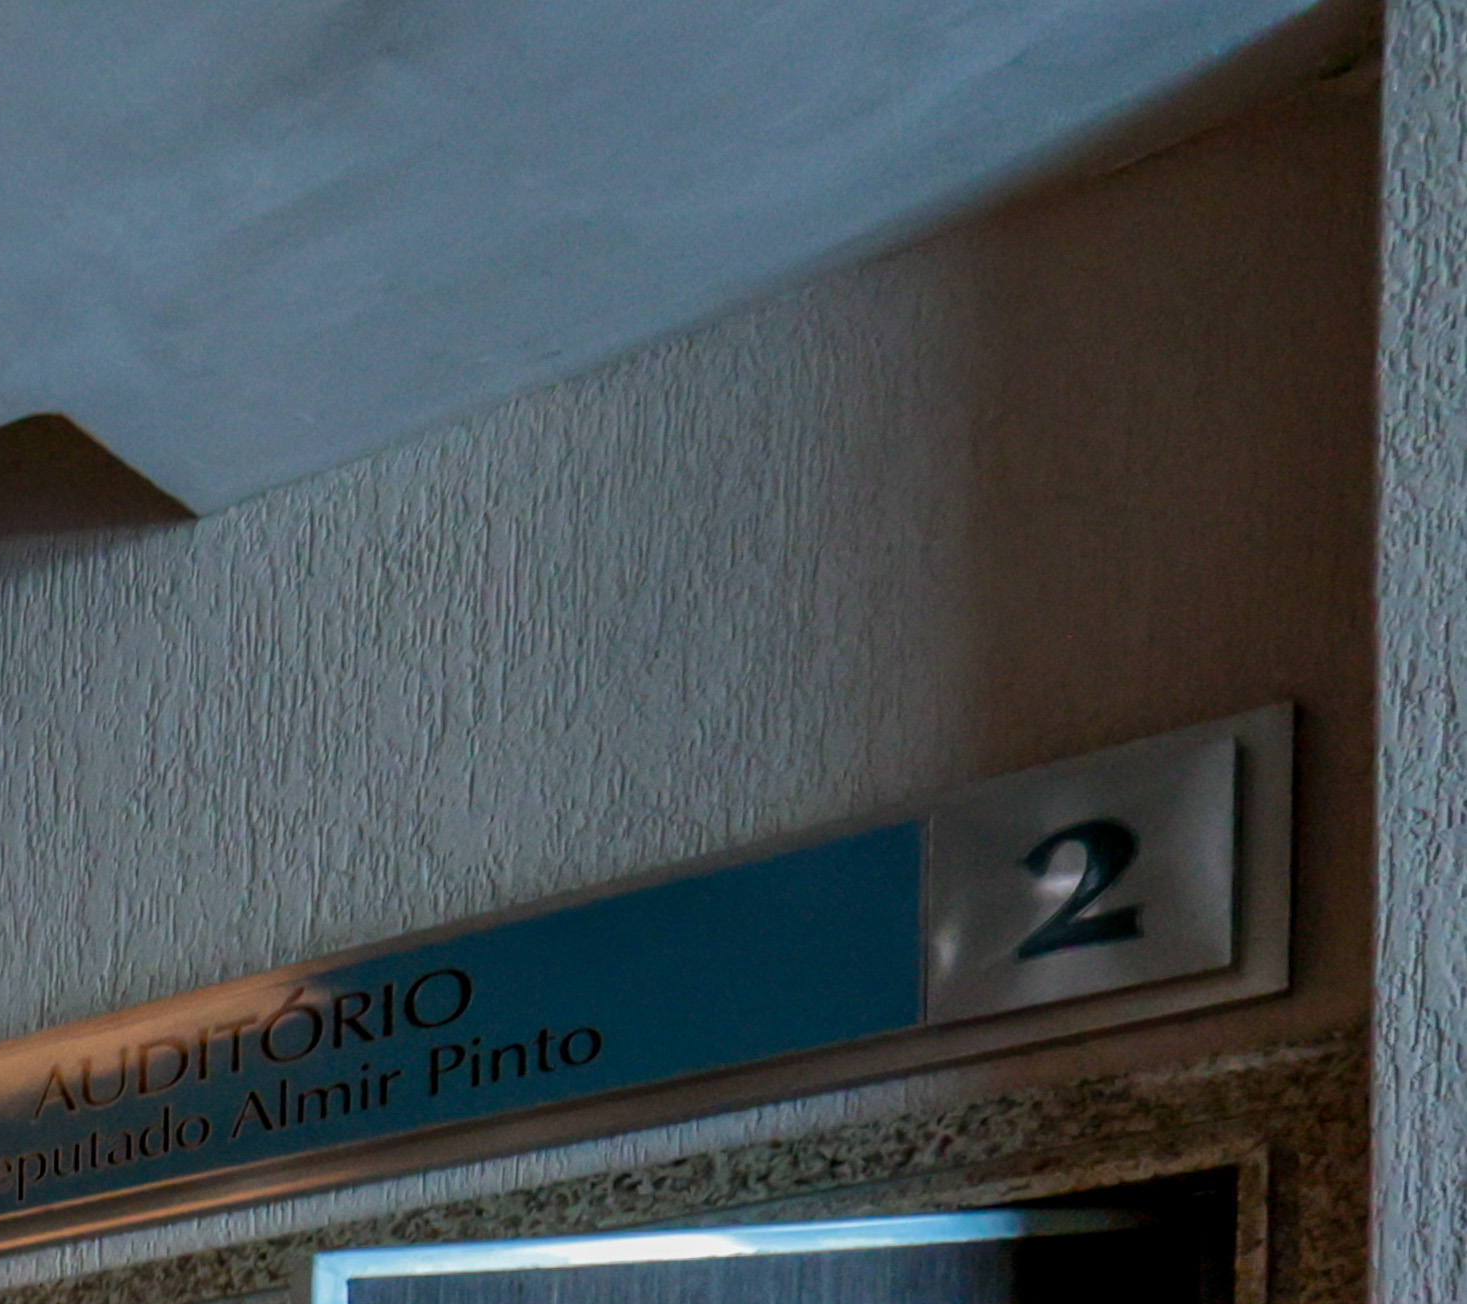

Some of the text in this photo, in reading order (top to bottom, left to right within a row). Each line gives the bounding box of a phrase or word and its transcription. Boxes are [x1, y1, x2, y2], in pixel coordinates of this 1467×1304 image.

[1016, 818, 1144, 961] 2
[32, 967, 474, 1119] AUDITÓRIO
[230, 1062, 402, 1138] Almir
[427, 1025, 604, 1096] Pinto
